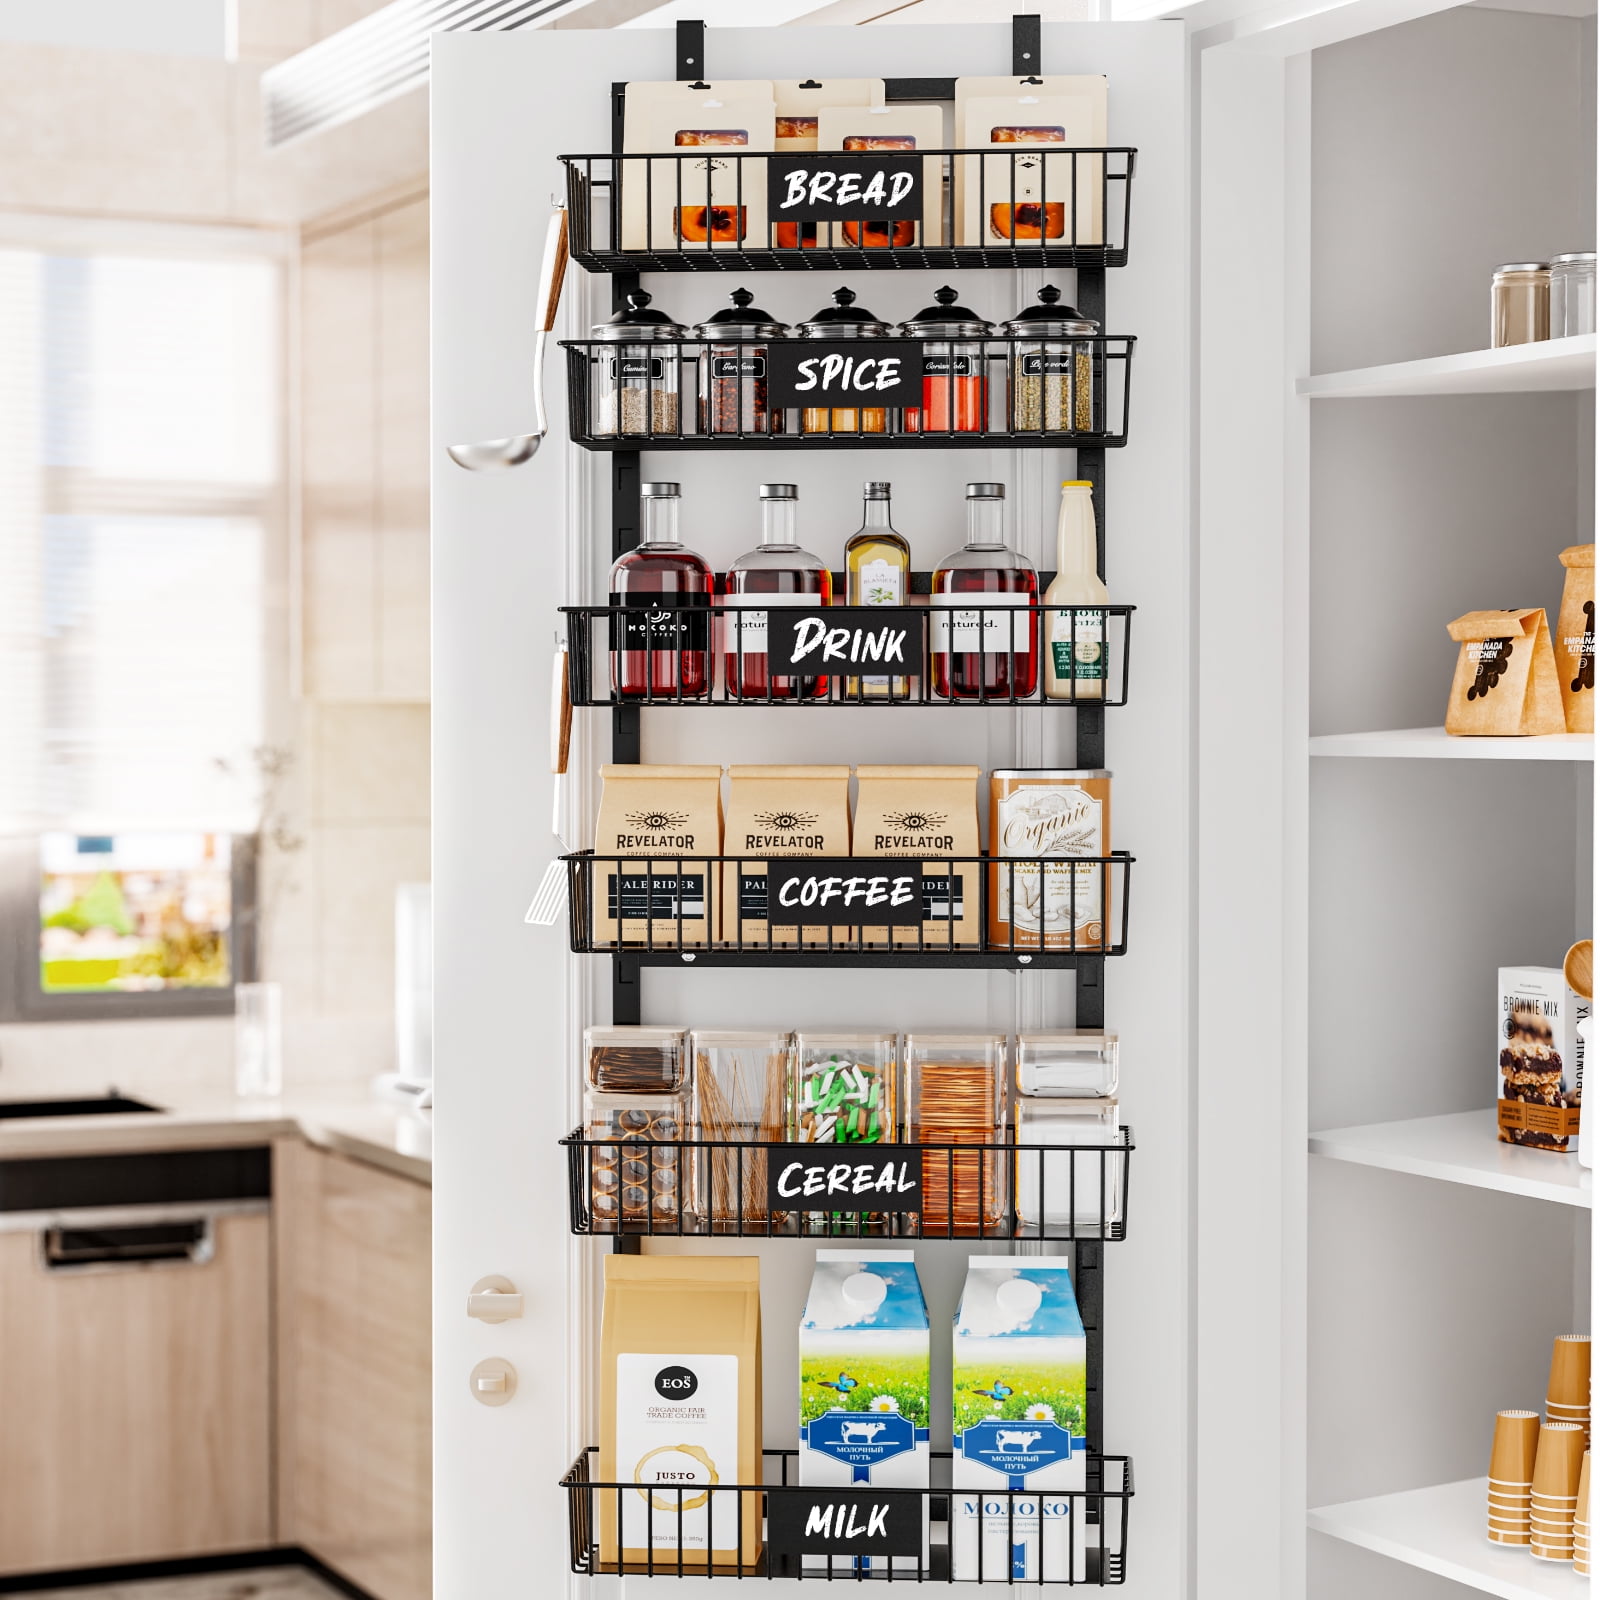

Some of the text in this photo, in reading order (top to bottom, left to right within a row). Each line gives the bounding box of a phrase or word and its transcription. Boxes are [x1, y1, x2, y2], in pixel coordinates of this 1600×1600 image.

[780, 170, 914, 209] BREAD
[795, 354, 901, 391] SPICE
[1003, 802, 1089, 851] Organic
[617, 834, 695, 850] REVELATOR
[746, 834, 824, 850] REVELATOR
[875, 834, 953, 850] REVELATOR
[779, 876, 914, 907] COFFEE
[1503, 995, 1559, 1017] BROWNIE MIX
[777, 1161, 917, 1198] CEREAL
[662, 1378, 691, 1389] EOS
[836, 1445, 884, 1454] МОЛОЧНЫЙ
[656, 1472, 696, 1481] JUSTO
[964, 1502, 1069, 1516] МОЛОКО
[805, 1504, 889, 1538] MILK
